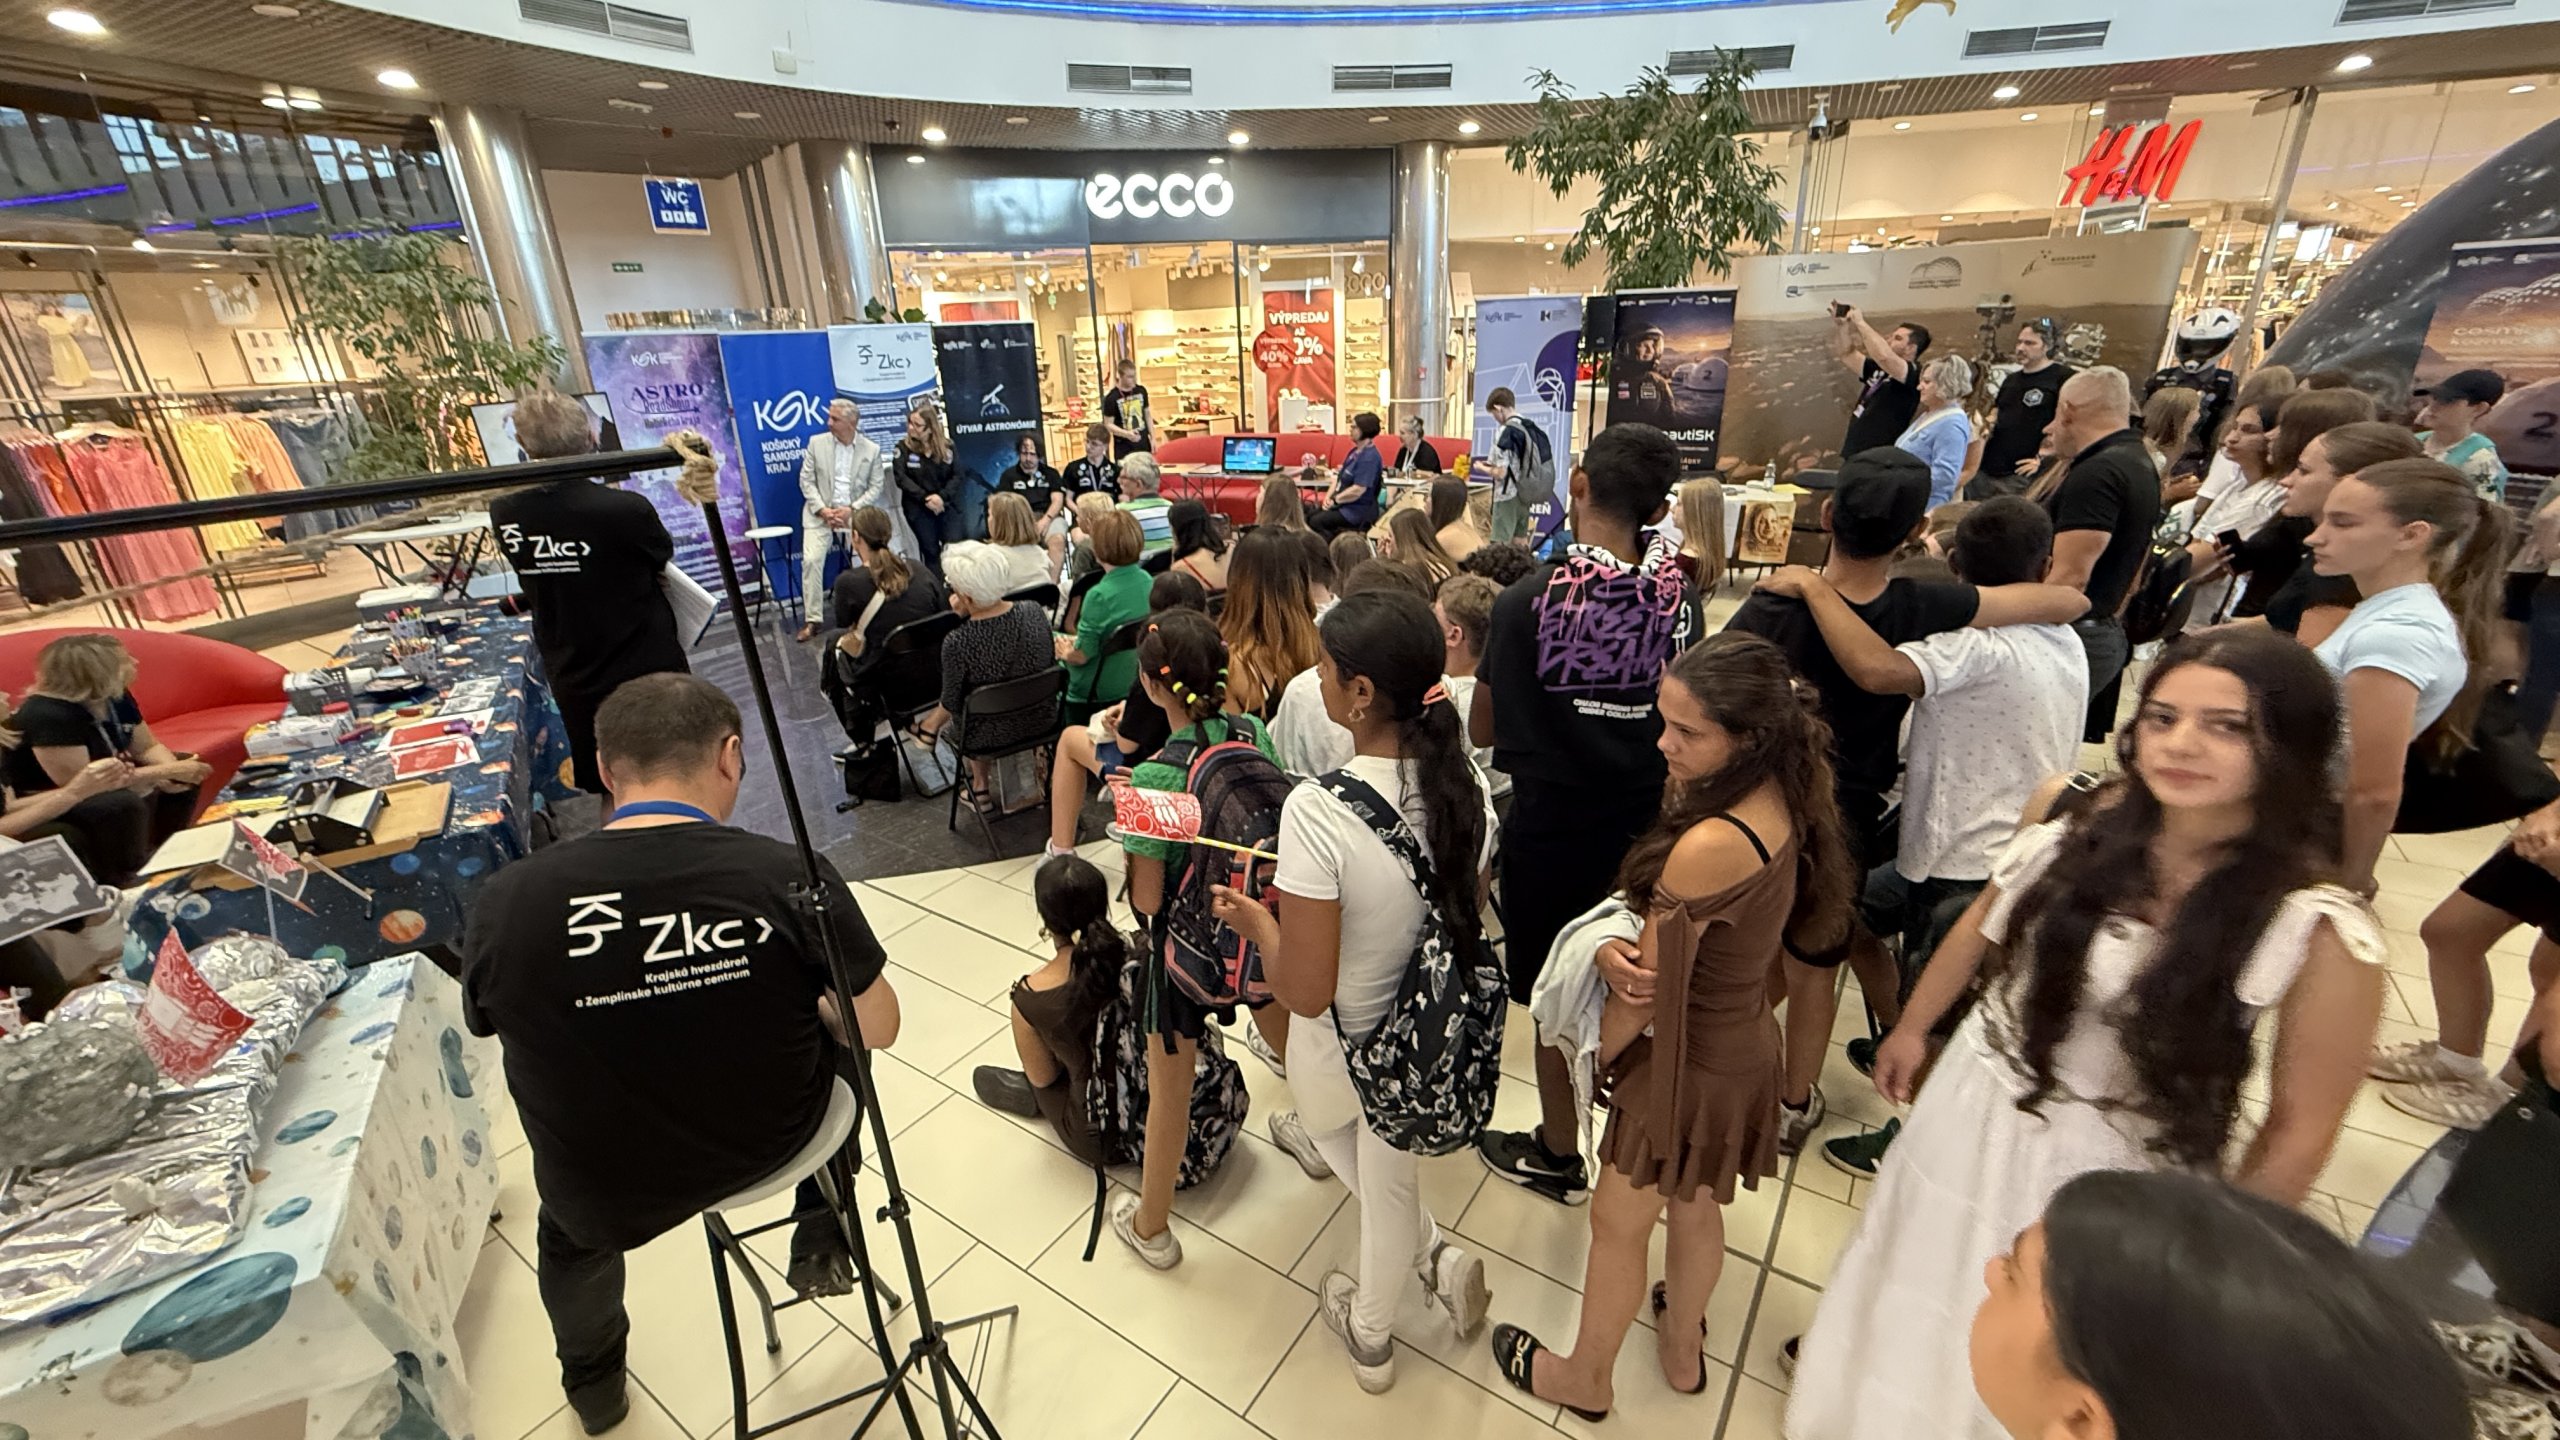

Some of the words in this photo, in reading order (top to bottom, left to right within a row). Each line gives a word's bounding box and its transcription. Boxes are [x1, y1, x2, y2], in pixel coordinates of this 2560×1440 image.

[2060, 118, 2203, 206] H&M
[661, 189, 689, 205] WC
[1085, 173, 1234, 219] ecco
[1269, 310, 1330, 325] VÝPREDAJ
[1259, 351, 1289, 362] 40%
[631, 383, 704, 401] ASTRO
[956, 423, 982, 434] ÚTVAR
[985, 419, 1037, 431] ASTRONÓMIE
[2525, 411, 2559, 438] 2
[761, 436, 801, 452] KOŠICKÝ
[765, 461, 791, 475] KRAJ
[527, 535, 578, 559] Zkc
[639, 912, 745, 963] Zkc
[645, 967, 689, 984] Krajská
[690, 955, 749, 976] hvezdáreň
[575, 998, 584, 1008] a
[585, 988, 652, 1008] Zemplínske
[654, 978, 702, 996] kultúrne
[704, 969, 751, 986] centrum
